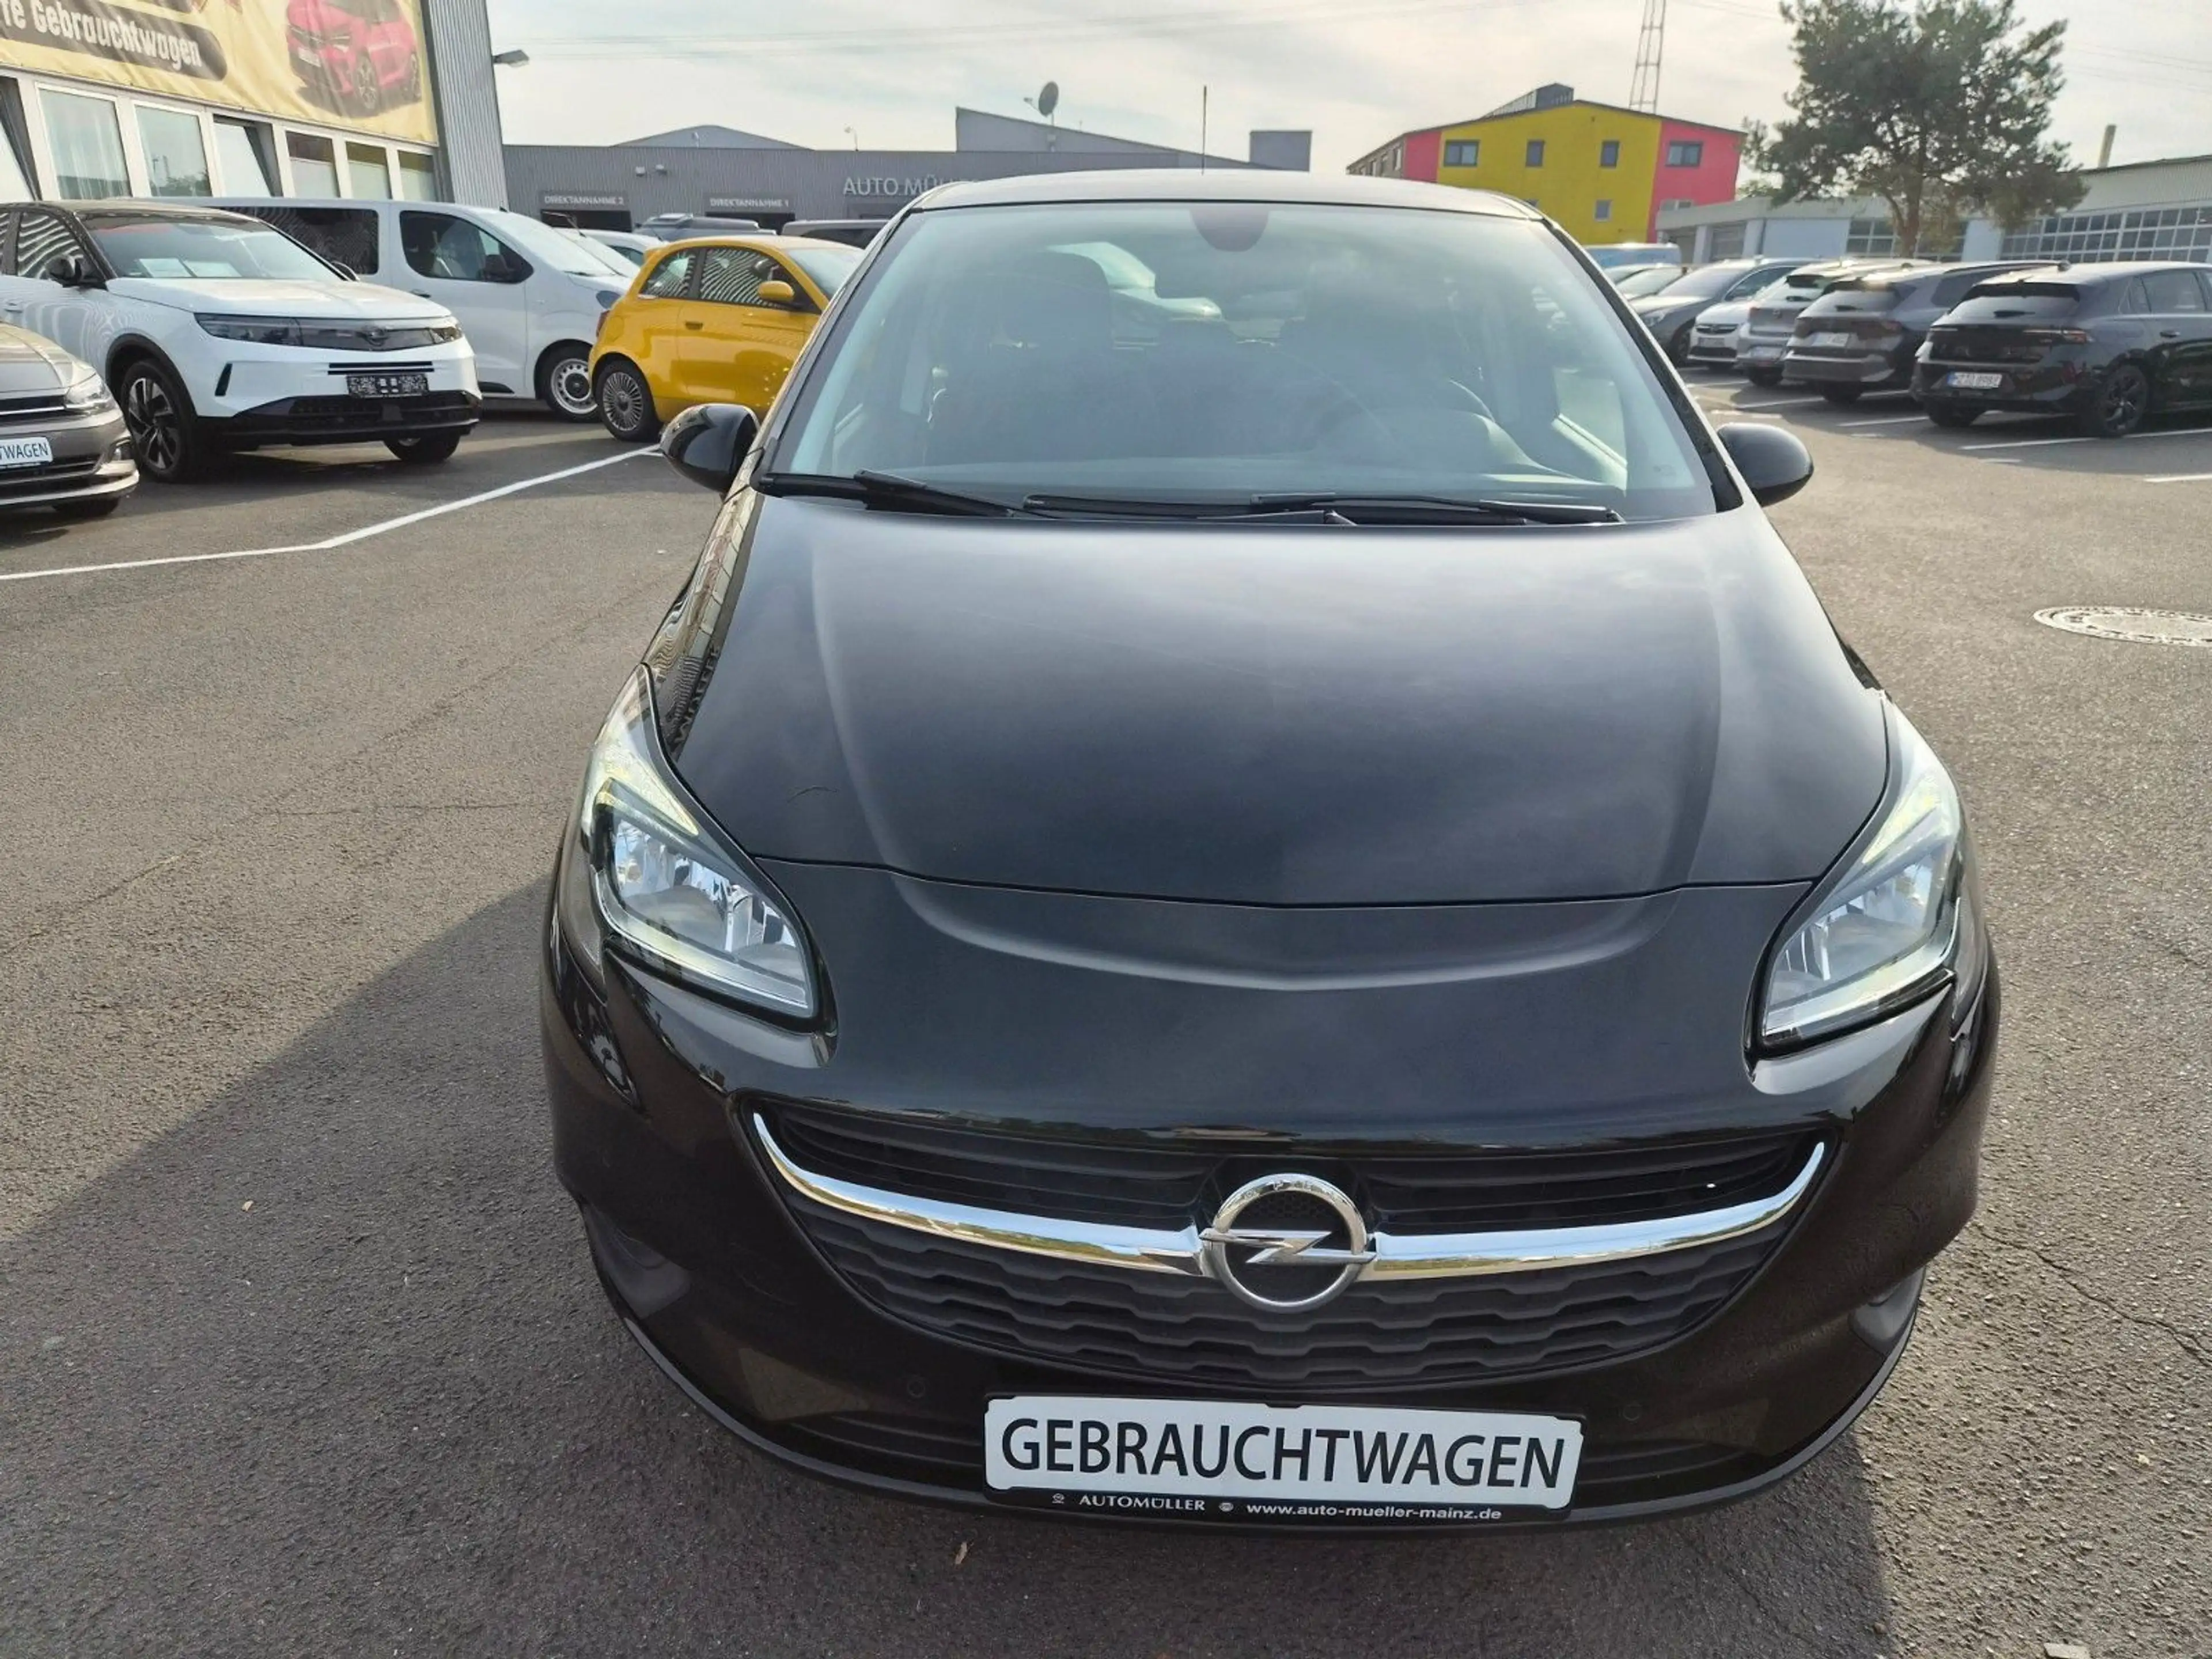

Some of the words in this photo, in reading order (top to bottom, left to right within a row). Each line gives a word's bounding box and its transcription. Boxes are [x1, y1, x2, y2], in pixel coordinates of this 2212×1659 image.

[31, 0, 202, 70] Gebrauchtwagen
[843, 177, 899, 195] AUTO
[1002, 1418, 1565, 1488] GEBRAUCHTWAGEN
[1079, 1495, 1206, 1511] AUTOMÜLLER
[1246, 1504, 1502, 1520] www.auto-mueller-mainz.de
